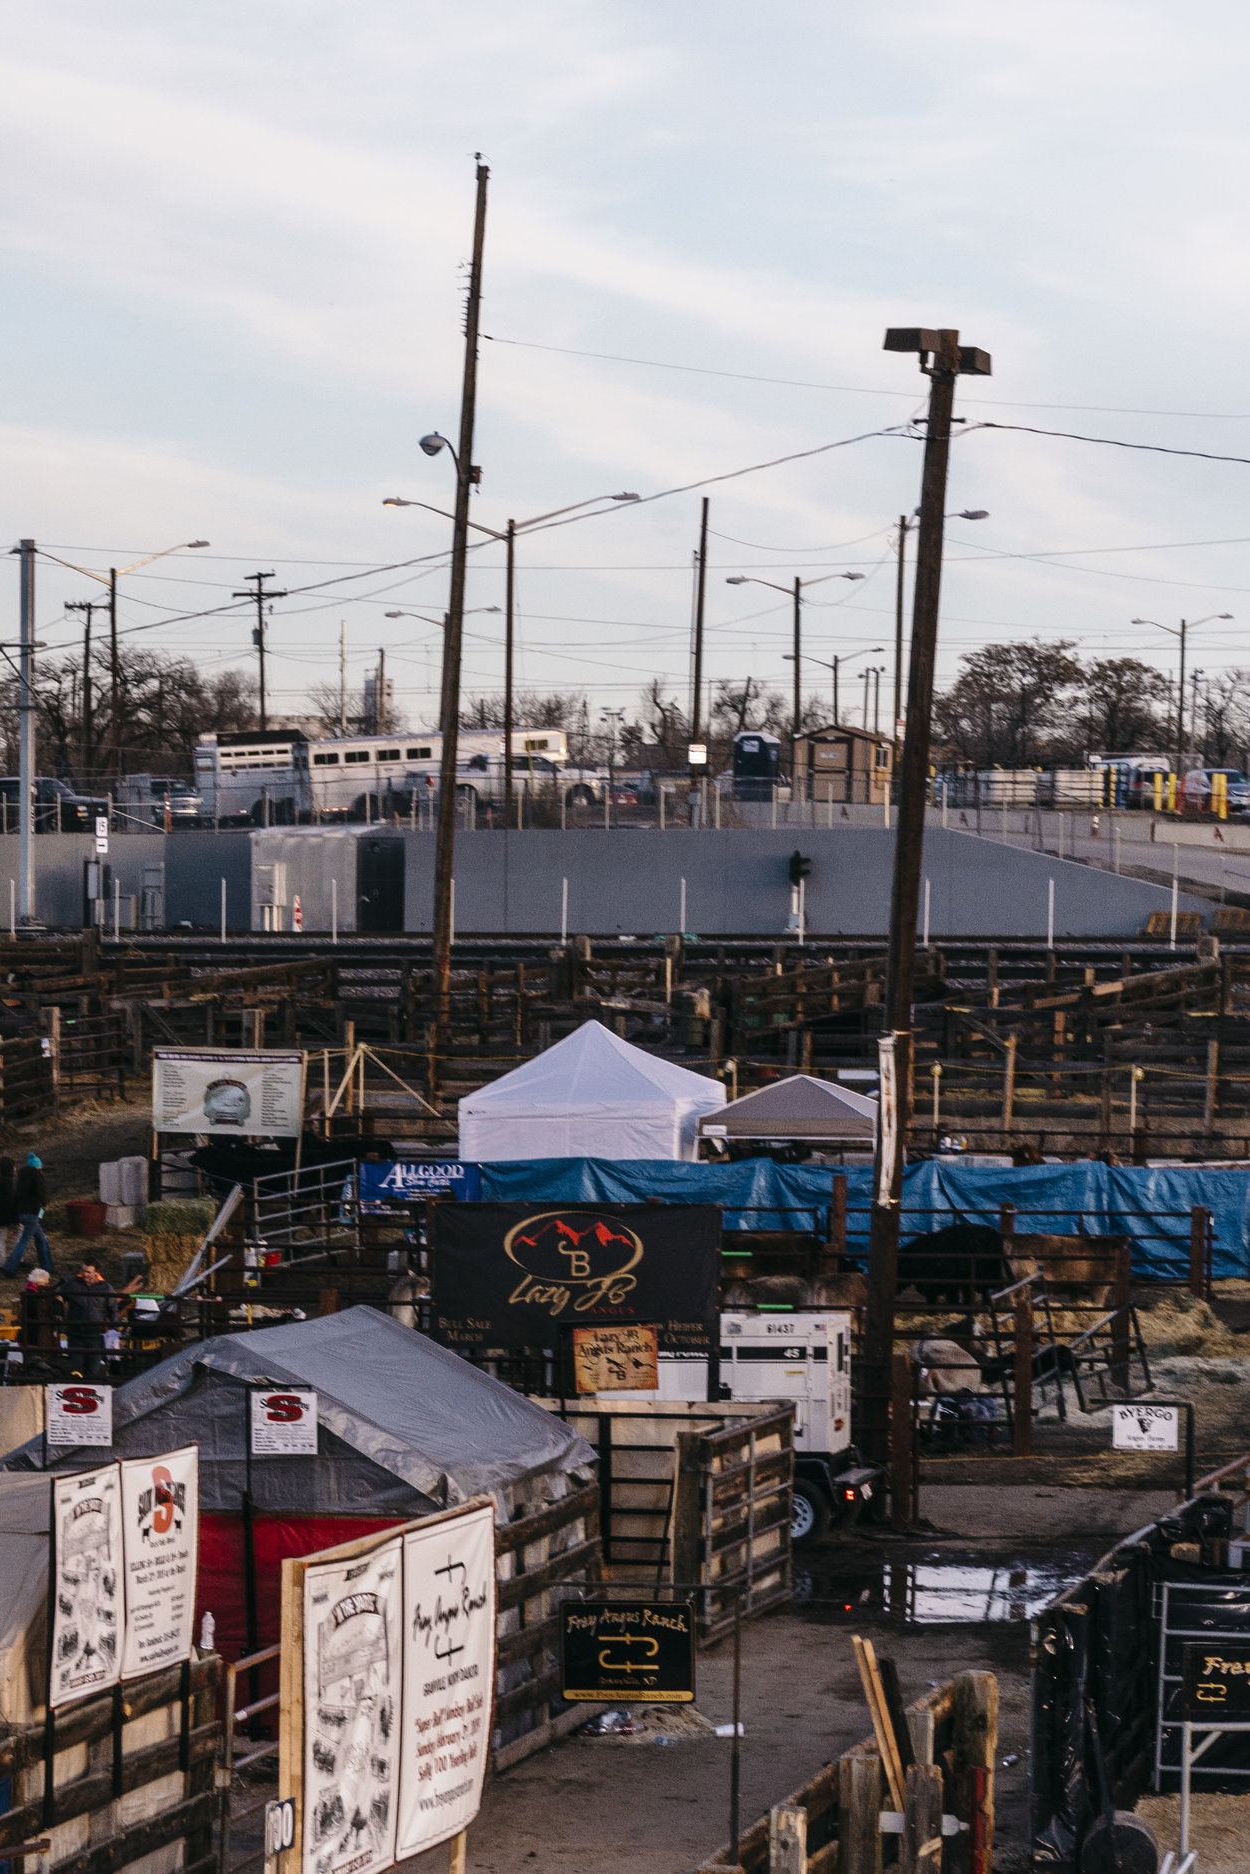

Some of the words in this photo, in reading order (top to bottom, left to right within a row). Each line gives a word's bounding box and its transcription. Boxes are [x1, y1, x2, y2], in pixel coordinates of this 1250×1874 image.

[378, 1163, 465, 1188] ALLGOOD
[508, 1274, 571, 1316] Lazy
[573, 1273, 638, 1312] JB
[590, 1306, 636, 1315] ANGUS
[461, 1580, 487, 1618] Ranch
[567, 1615, 598, 1636] Frey
[599, 1608, 640, 1633] Angus
[641, 1608, 689, 1633] Ranch
